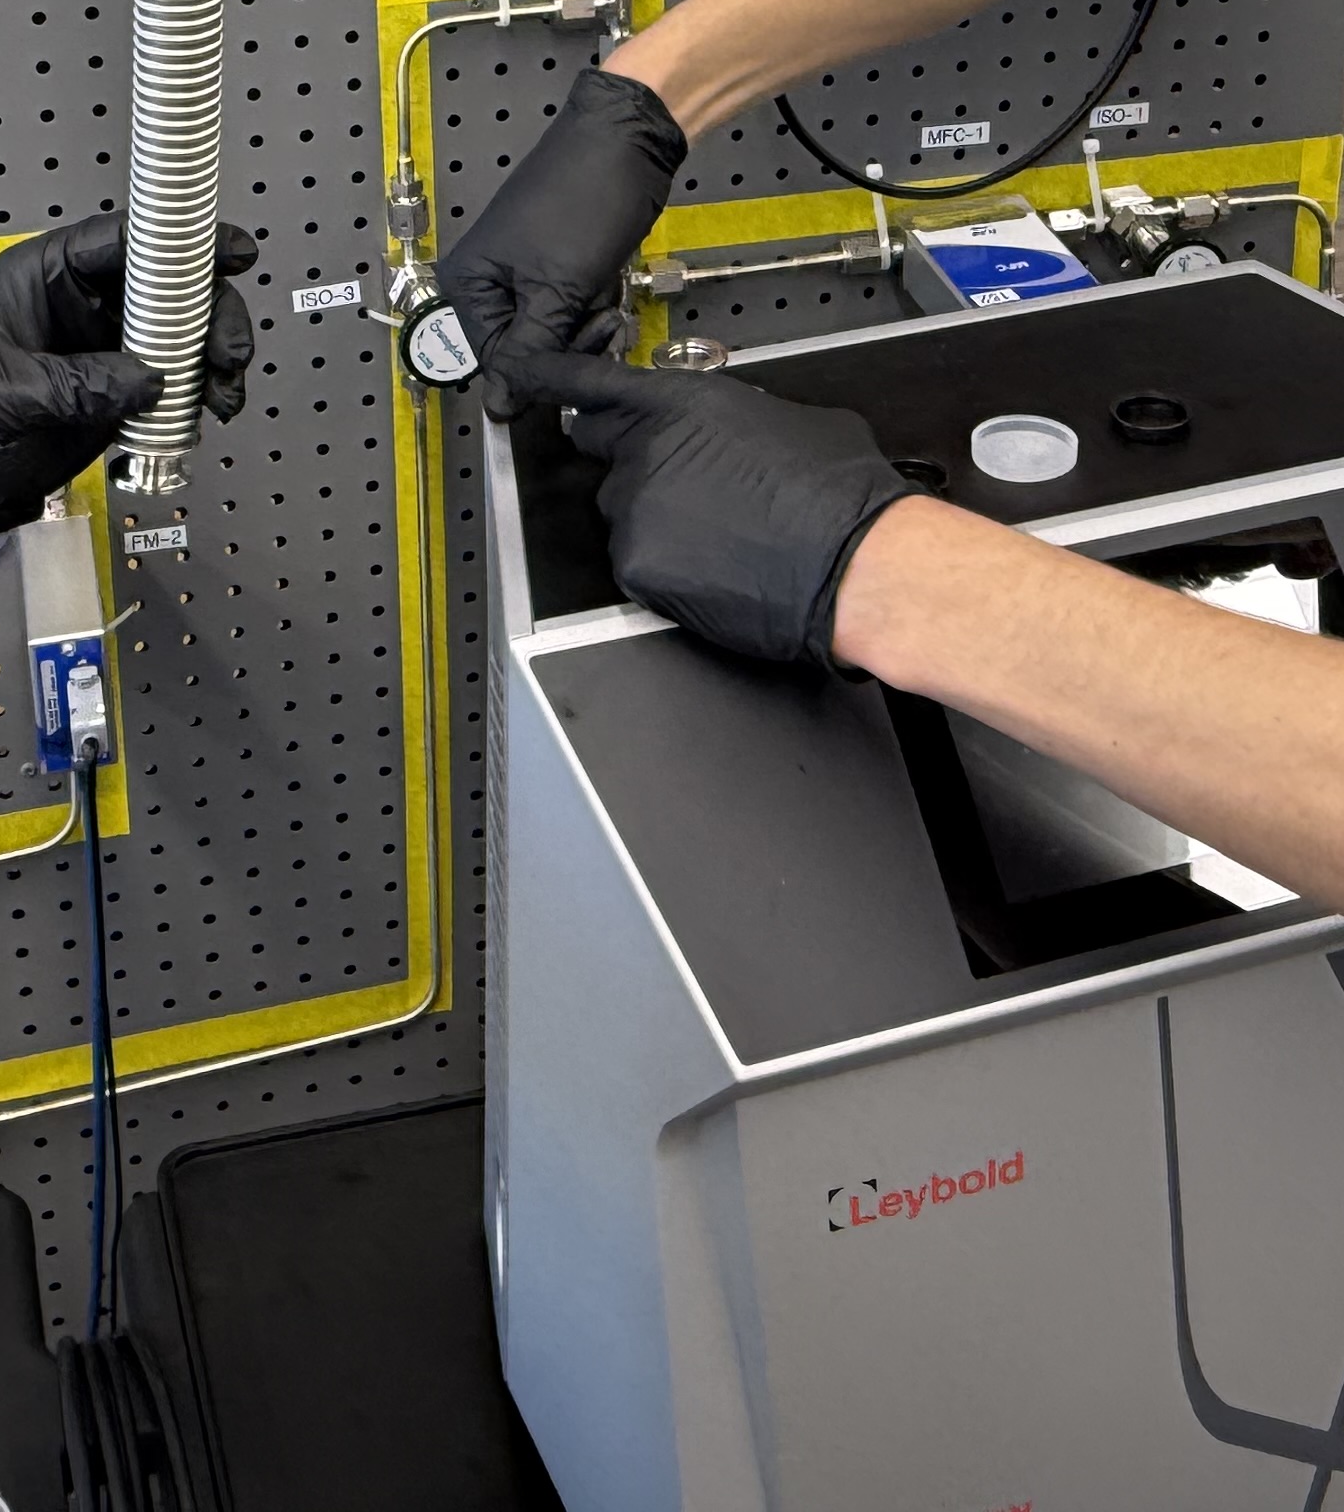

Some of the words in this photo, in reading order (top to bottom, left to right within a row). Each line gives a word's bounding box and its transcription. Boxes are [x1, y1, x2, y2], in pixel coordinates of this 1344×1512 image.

[1096, 106, 1144, 124] ISO-1
[927, 125, 984, 144] MFC-1
[301, 286, 355, 308] ISO-3
[131, 530, 182, 550] FM-2
[849, 1149, 1024, 1226] Leybold
